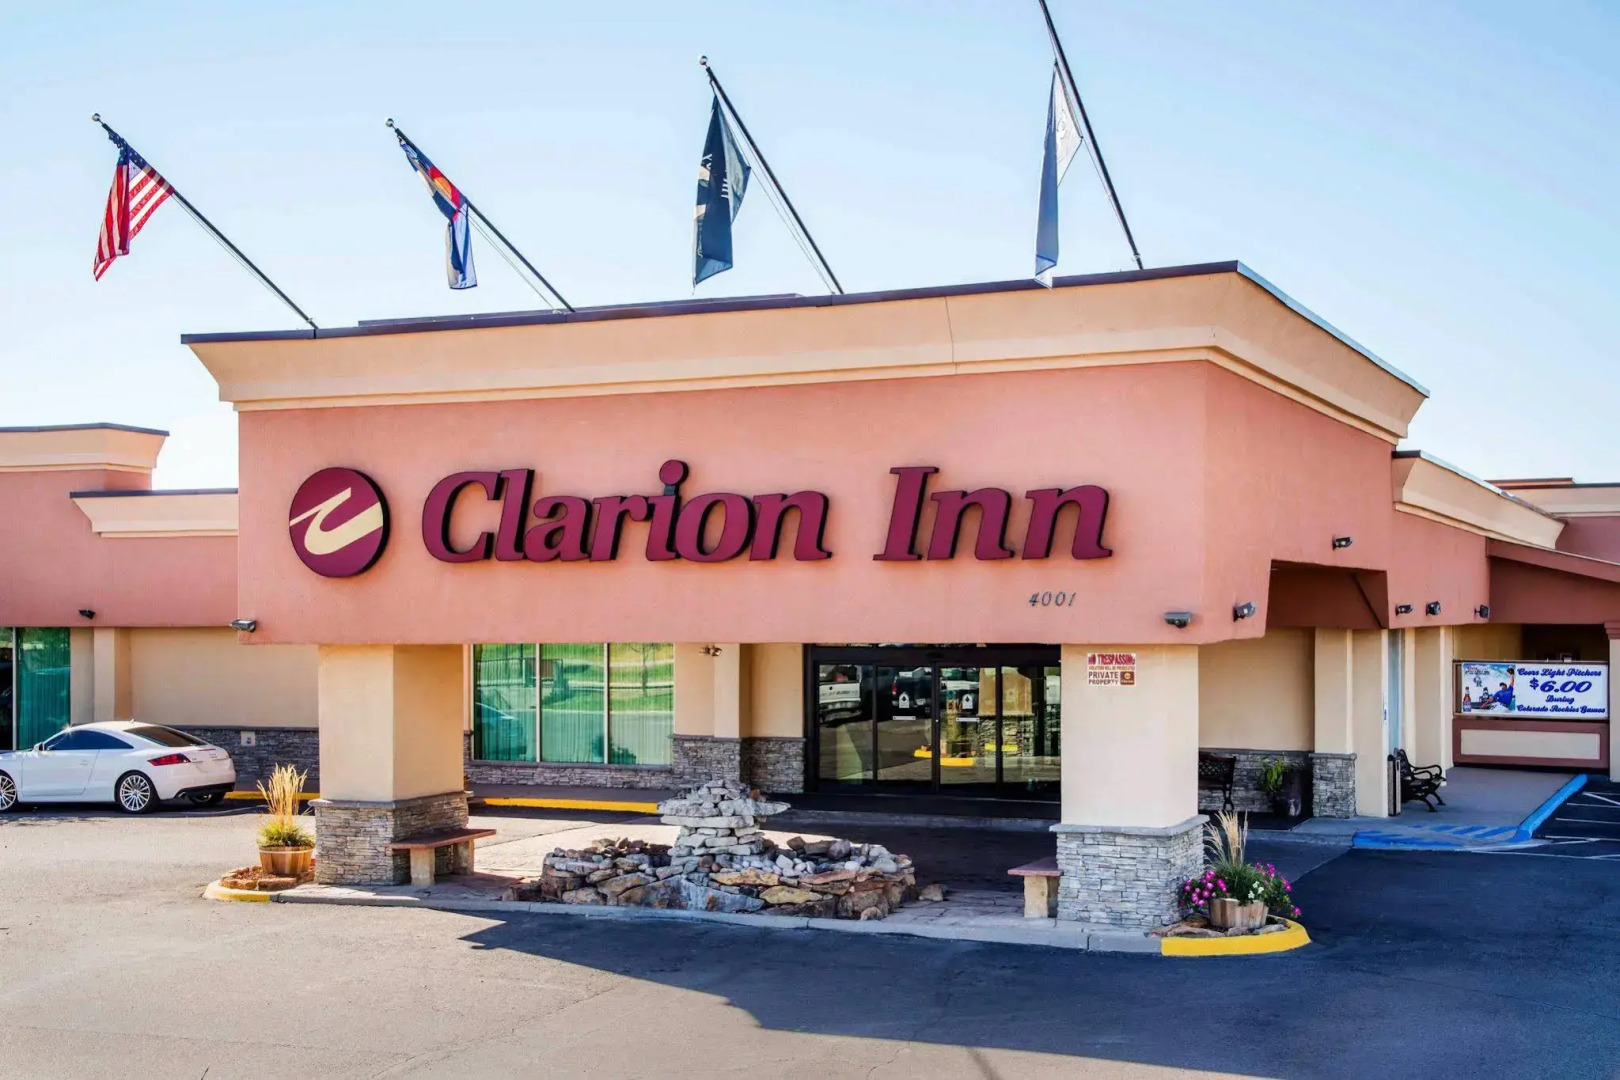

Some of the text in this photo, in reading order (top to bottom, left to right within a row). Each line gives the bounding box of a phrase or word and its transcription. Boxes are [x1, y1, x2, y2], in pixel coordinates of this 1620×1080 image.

[422, 460, 1113, 563] Clarion Inn
[1029, 591, 1076, 607] 4001
[1517, 668, 1601, 678] Coors Light Pitchers
[1529, 677, 1592, 693] $6.00
[1545, 695, 1575, 704] During
[1516, 704, 1605, 714] Colorado Rockies Games
